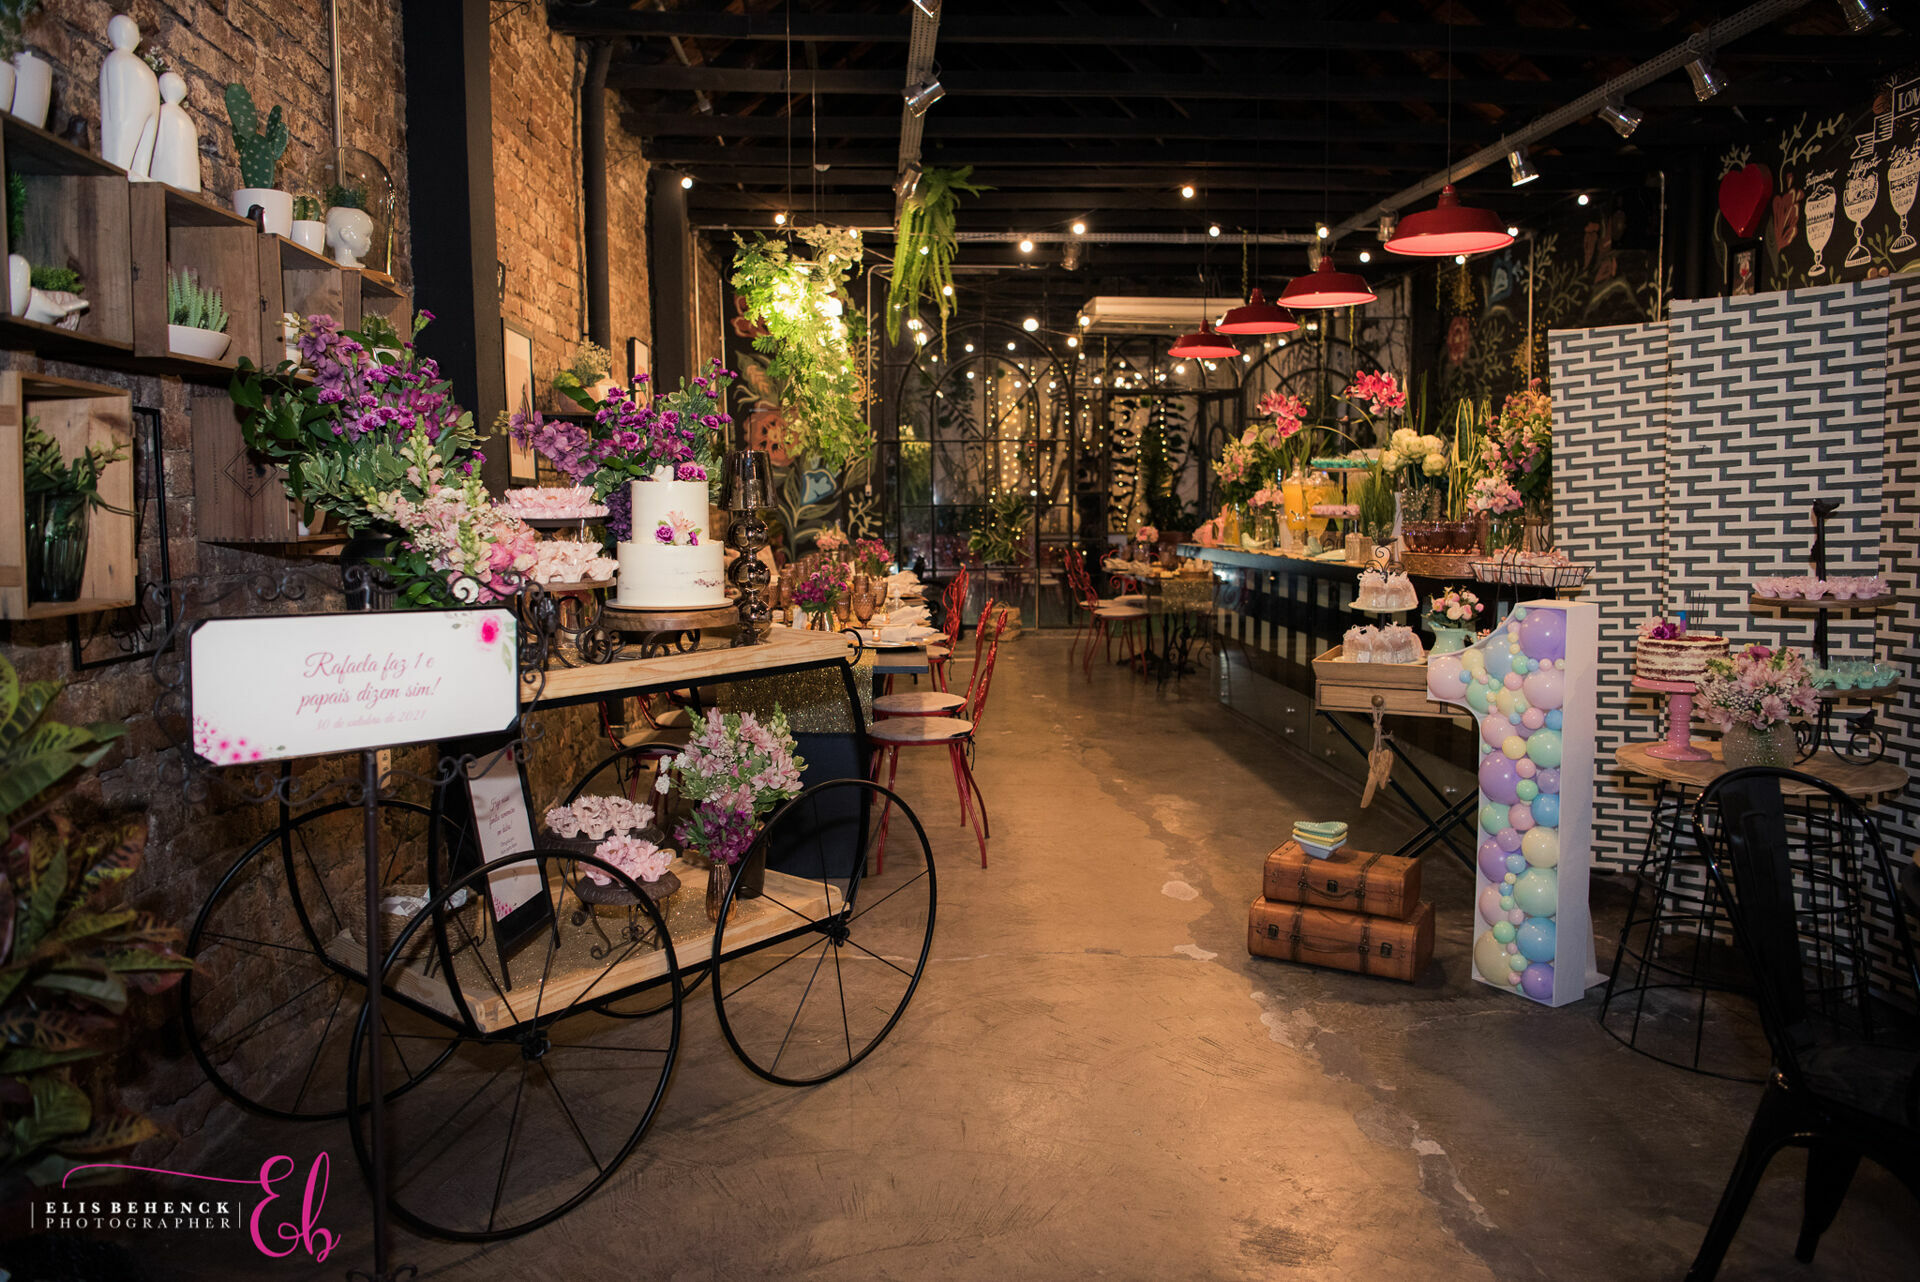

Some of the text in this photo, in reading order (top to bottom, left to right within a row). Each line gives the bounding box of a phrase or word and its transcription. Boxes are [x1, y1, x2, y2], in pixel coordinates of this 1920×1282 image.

[303, 652, 435, 684] Rafaela faz 1 e
[296, 677, 442, 715] papais dizem sim!
